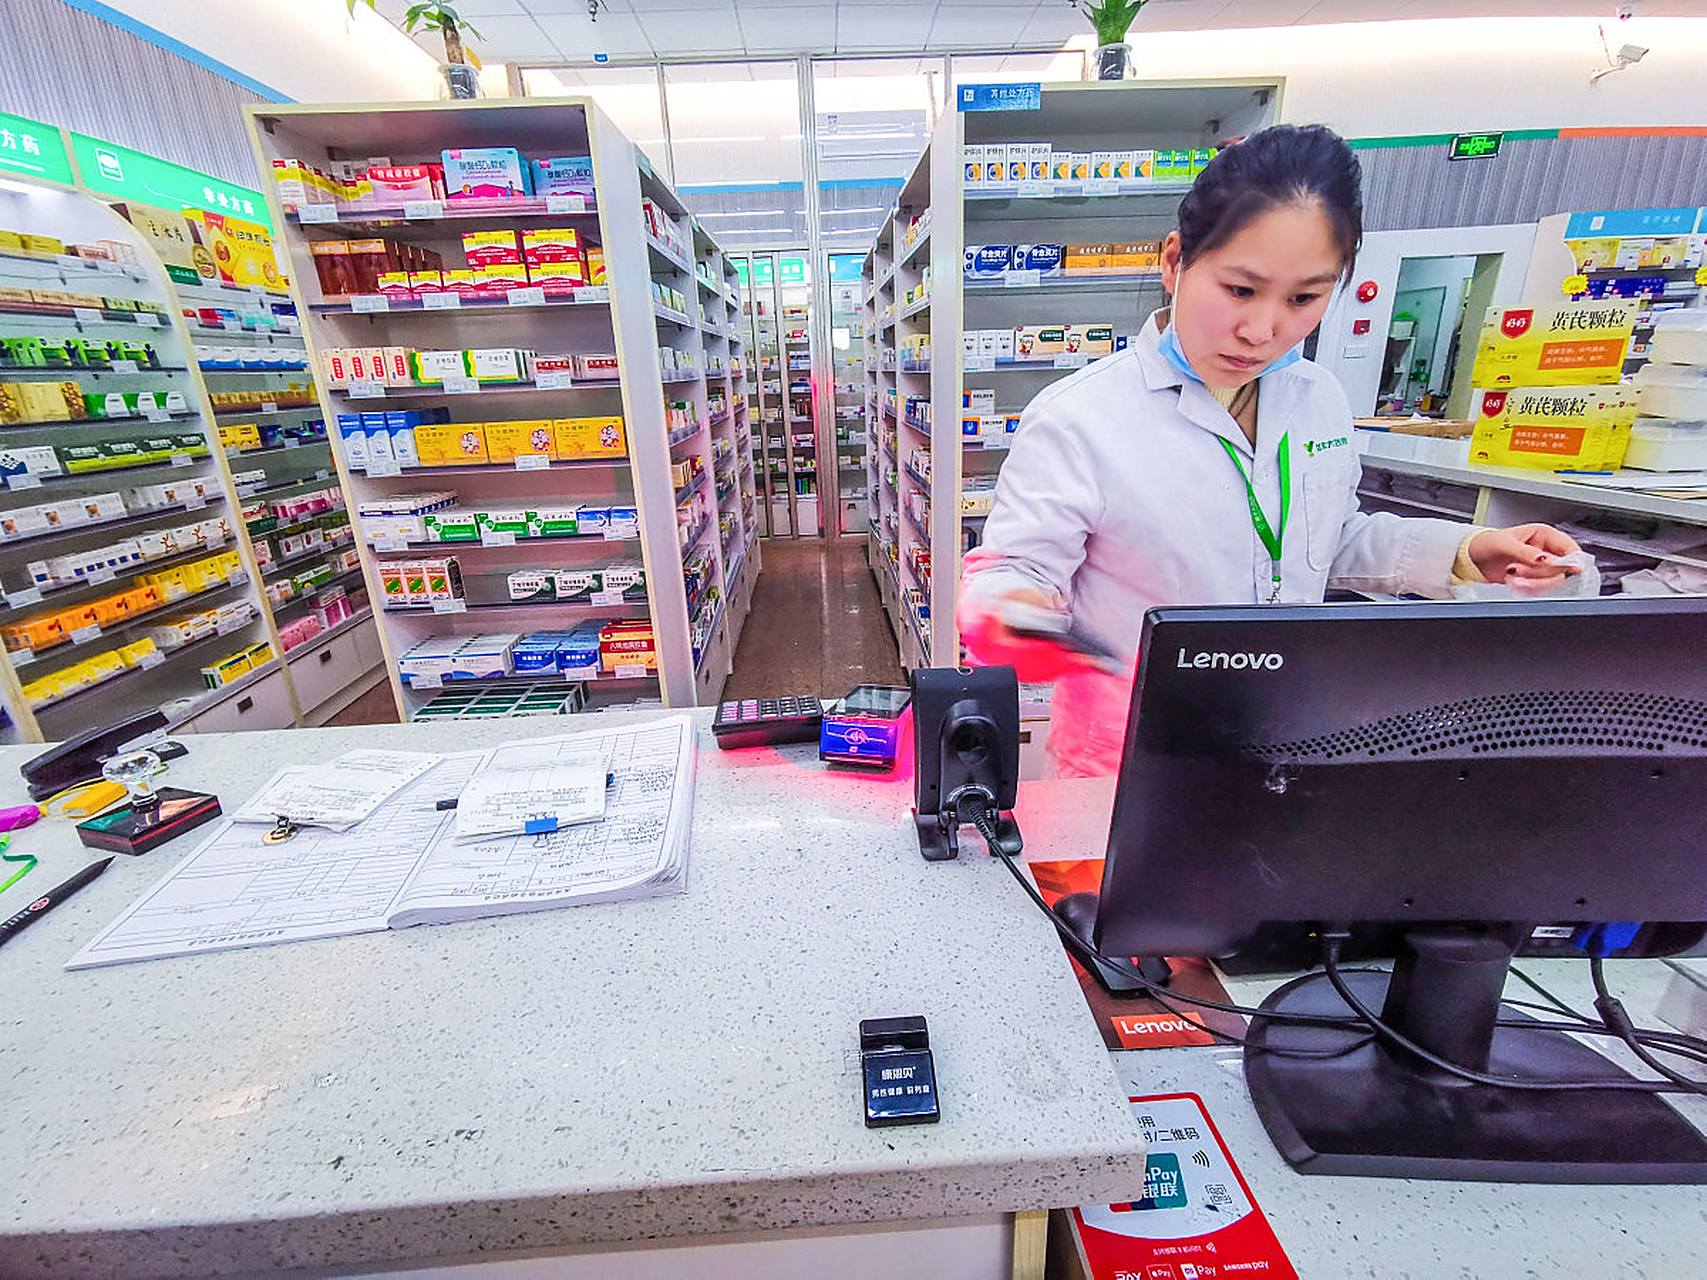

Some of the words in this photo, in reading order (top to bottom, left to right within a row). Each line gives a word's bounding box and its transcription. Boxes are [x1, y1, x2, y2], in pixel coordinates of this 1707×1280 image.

[1549, 308, 1627, 333] 黄芪颗粒
[1519, 396, 1588, 416] 黄芪颗粒
[1177, 648, 1284, 670] Lenovo
[1198, 1264, 1216, 1277] Pay
